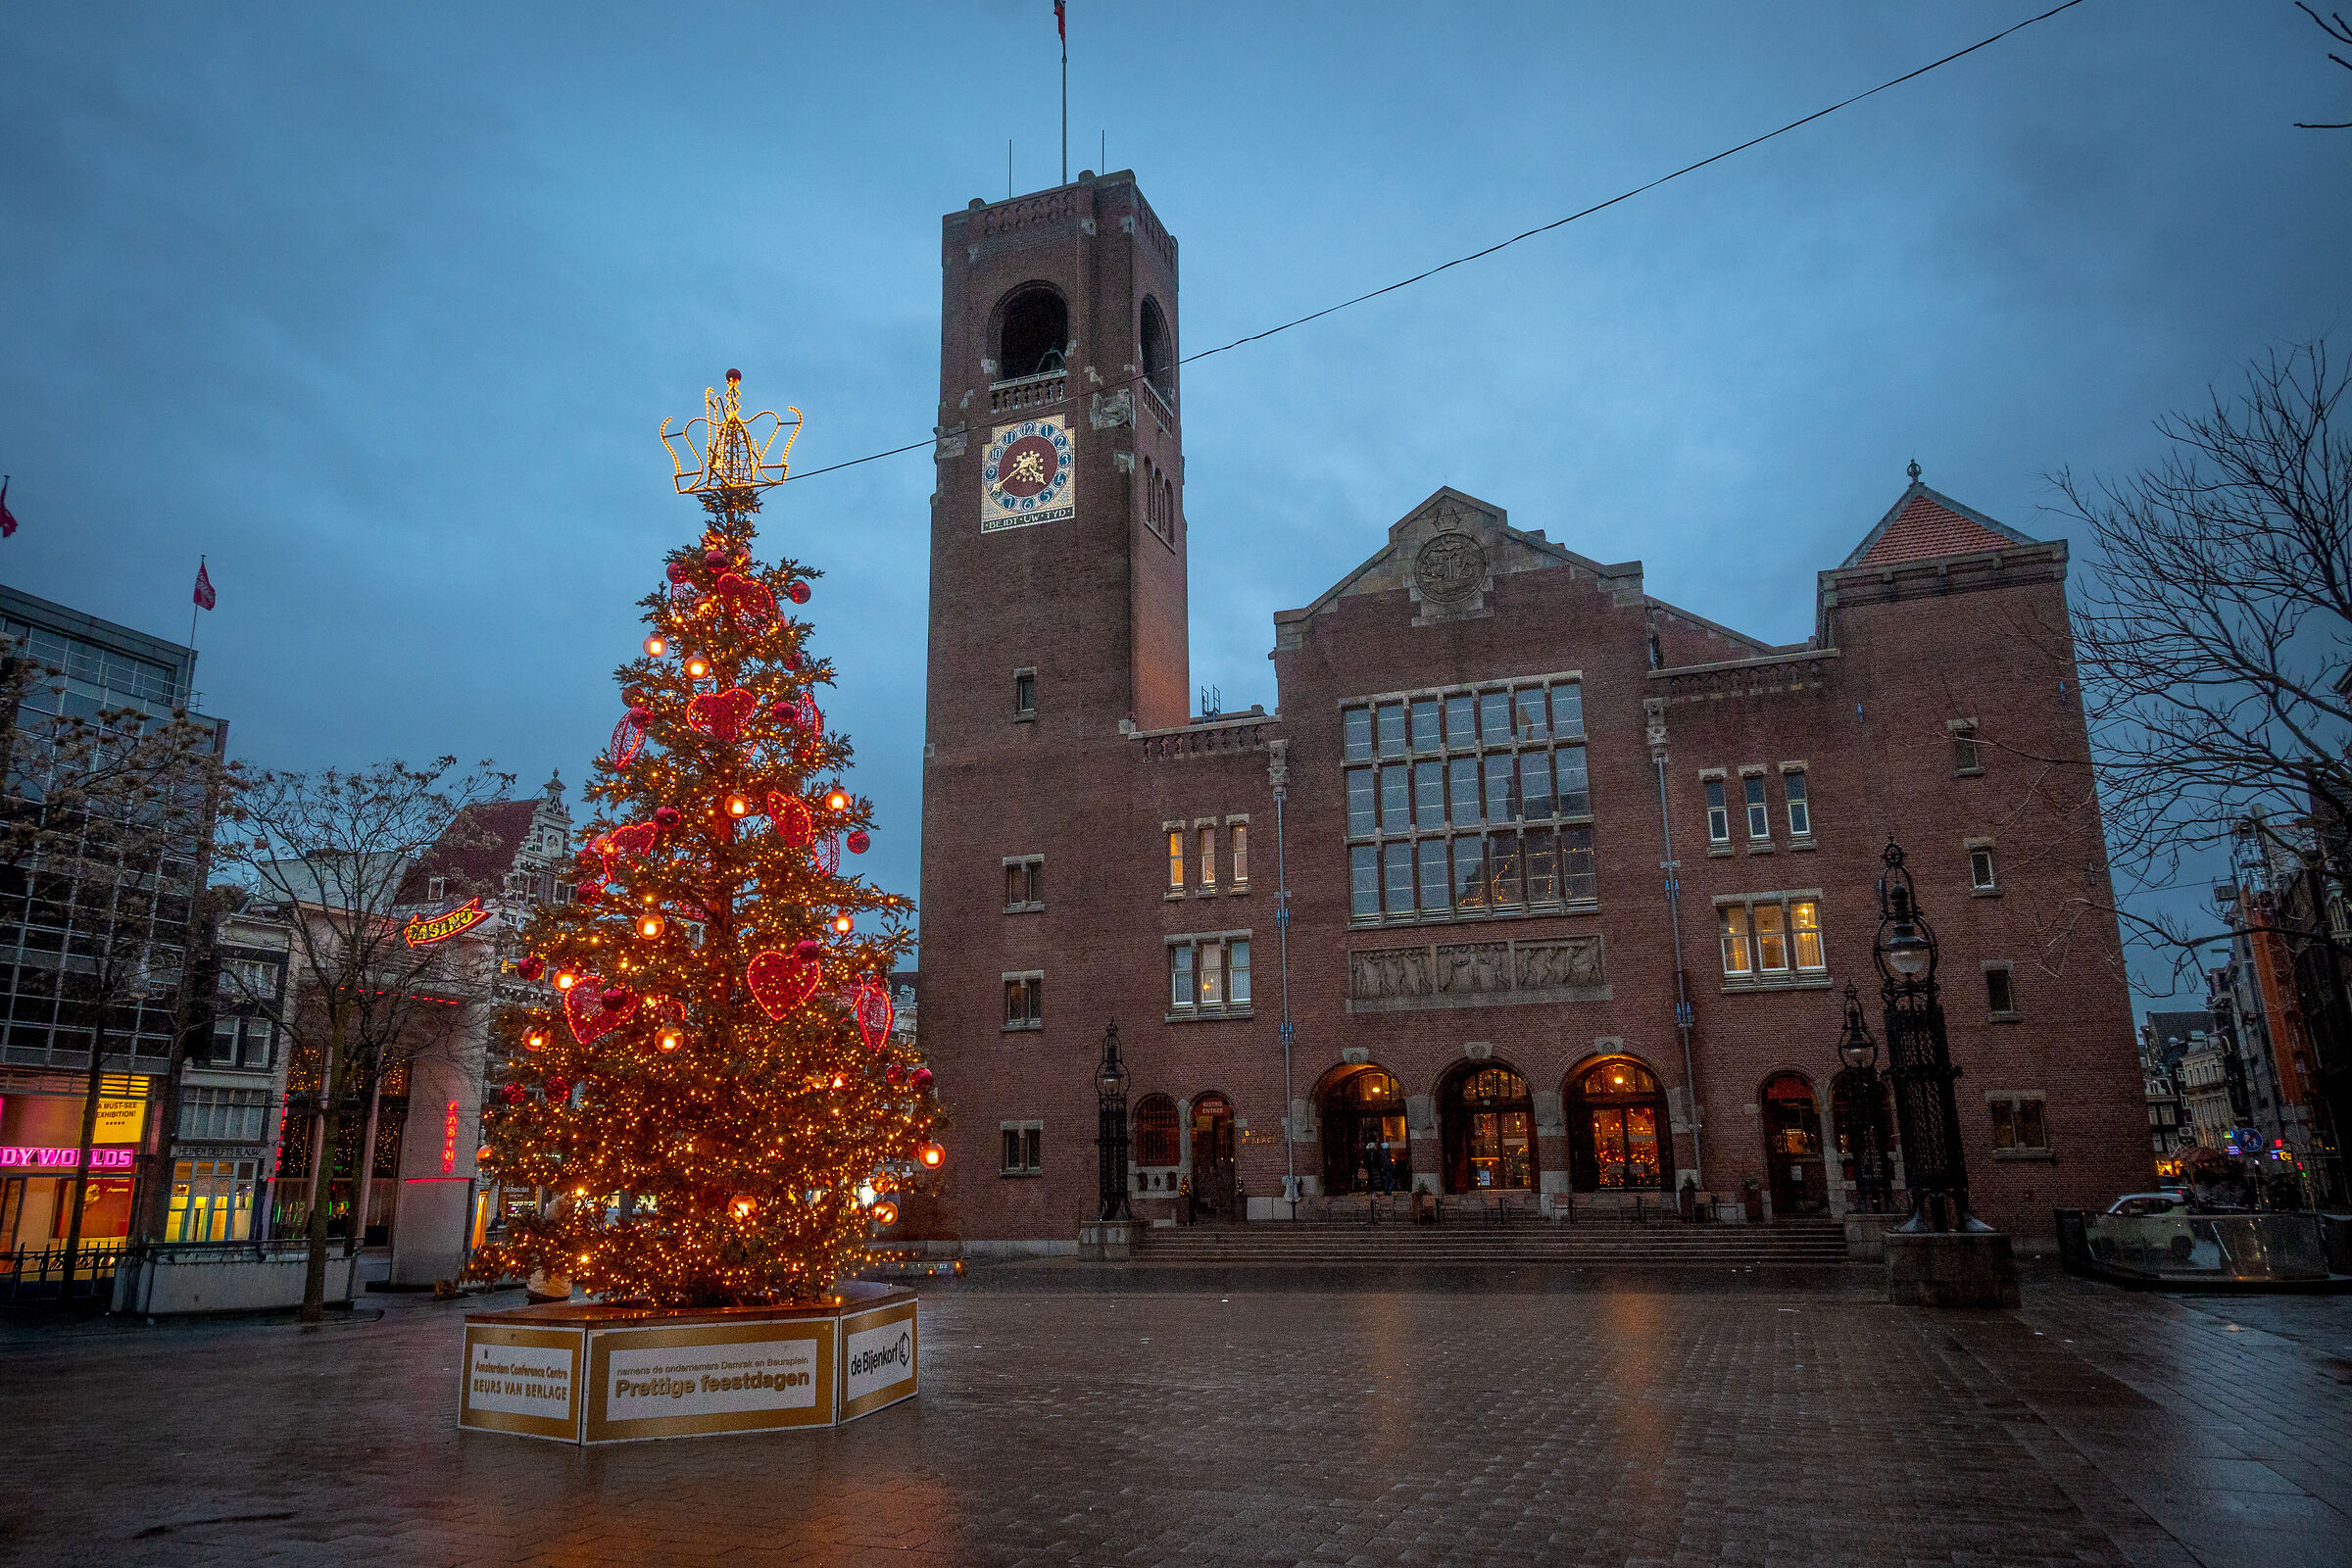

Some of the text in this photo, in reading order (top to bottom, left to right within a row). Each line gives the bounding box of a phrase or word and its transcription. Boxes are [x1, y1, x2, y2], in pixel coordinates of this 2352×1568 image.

[1023, 422, 1033, 433] 12
[1005, 431, 1013, 443] 11
[1056, 436, 1064, 448] 2
[991, 448, 1002, 460] 10
[1062, 454, 1069, 466] 3
[988, 468, 995, 479] 9
[1056, 473, 1065, 486] 4
[1006, 496, 1013, 508] 7
[1042, 490, 1051, 502] 5
[1024, 498, 1032, 511] 6
[407, 907, 473, 941] CASINO
[442, 1101, 458, 1173] CASINO
[38, 1148, 133, 1167] WOLDS
[851, 1342, 899, 1376] de Bijenkorf
[475, 1361, 568, 1380] Amsterdam Conference Centre
[616, 1367, 651, 1376] namens
[653, 1365, 663, 1375] de
[665, 1363, 719, 1374] ondernemers
[721, 1359, 753, 1370] Damrak
[766, 1356, 808, 1367] Beursplein
[473, 1379, 567, 1401] BEURS VAN BERLAGE
[615, 1371, 810, 1399] Prettige feestdagen
